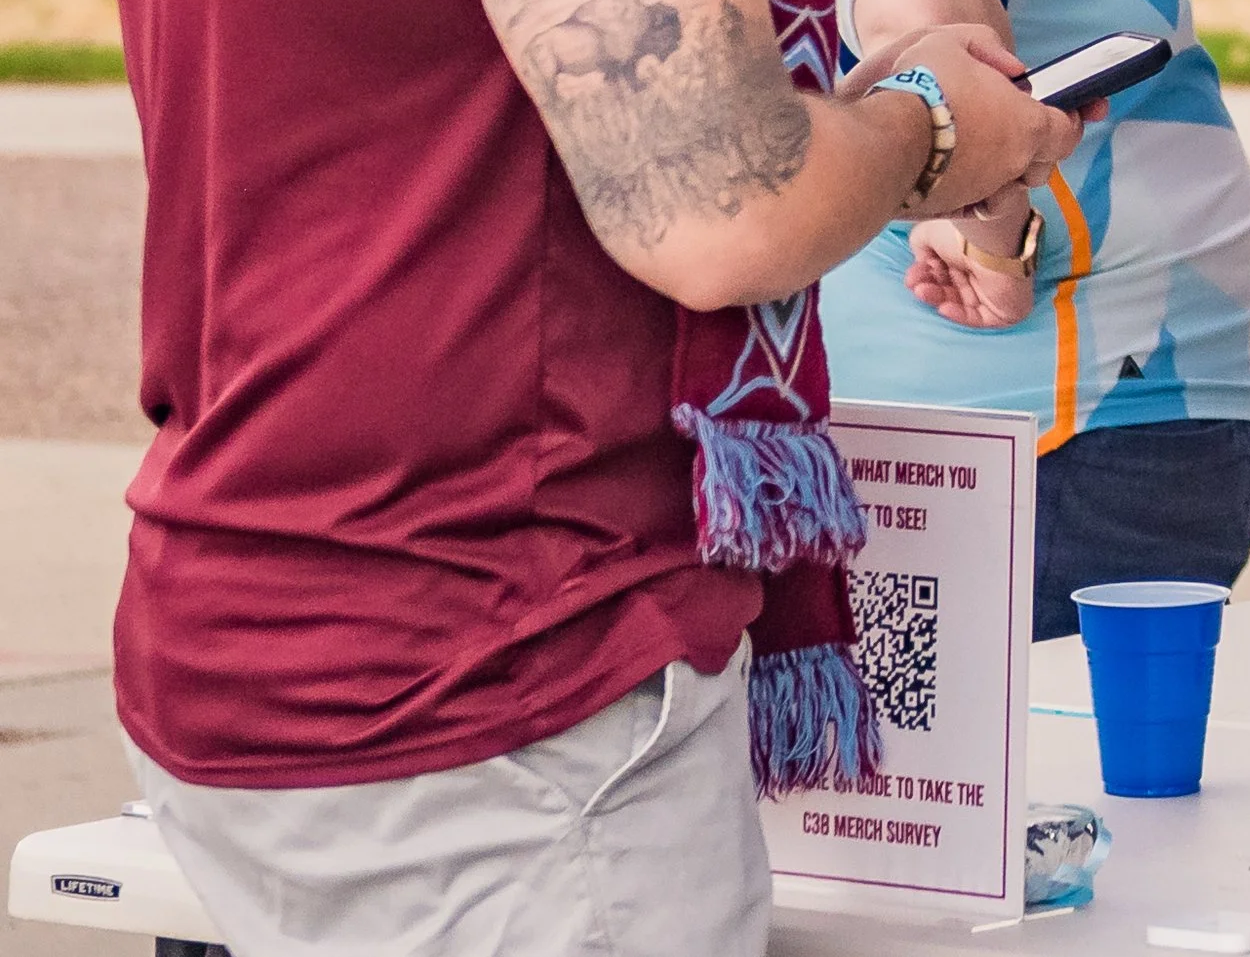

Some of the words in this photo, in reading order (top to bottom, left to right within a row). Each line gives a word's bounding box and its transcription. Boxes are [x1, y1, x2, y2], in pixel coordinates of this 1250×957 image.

[852, 458, 892, 483] WHAT
[895, 461, 945, 487] MERCH
[949, 466, 977, 490] YOU
[875, 505, 892, 529] TO
[896, 507, 927, 531] SEE!
[896, 776, 914, 800] TO
[918, 779, 953, 804] TAKE
[957, 782, 985, 807] THE
[803, 811, 830, 836] C38
[834, 814, 882, 841] MERCH
[886, 821, 942, 848] SURVEY
[60, 880, 114, 896] LIFETIME
